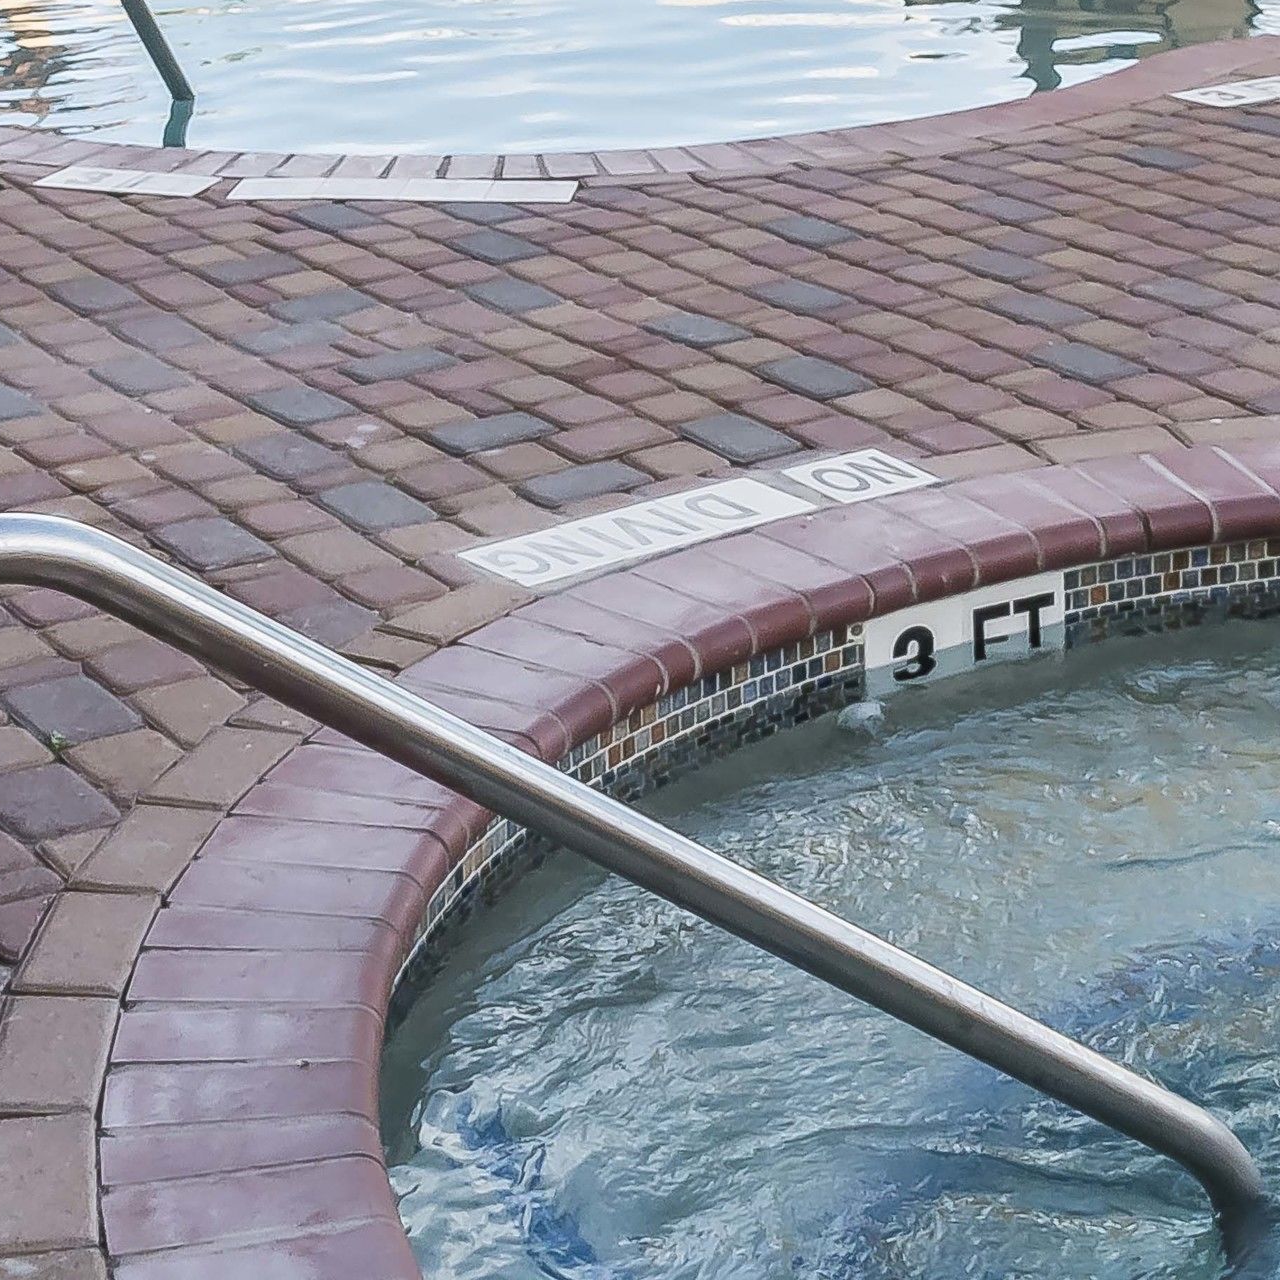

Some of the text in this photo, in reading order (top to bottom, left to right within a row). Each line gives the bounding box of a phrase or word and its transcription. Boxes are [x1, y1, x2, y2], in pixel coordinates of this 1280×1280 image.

[482, 456, 909, 575] NO DIVING
[893, 592, 1055, 681] 3 FT
